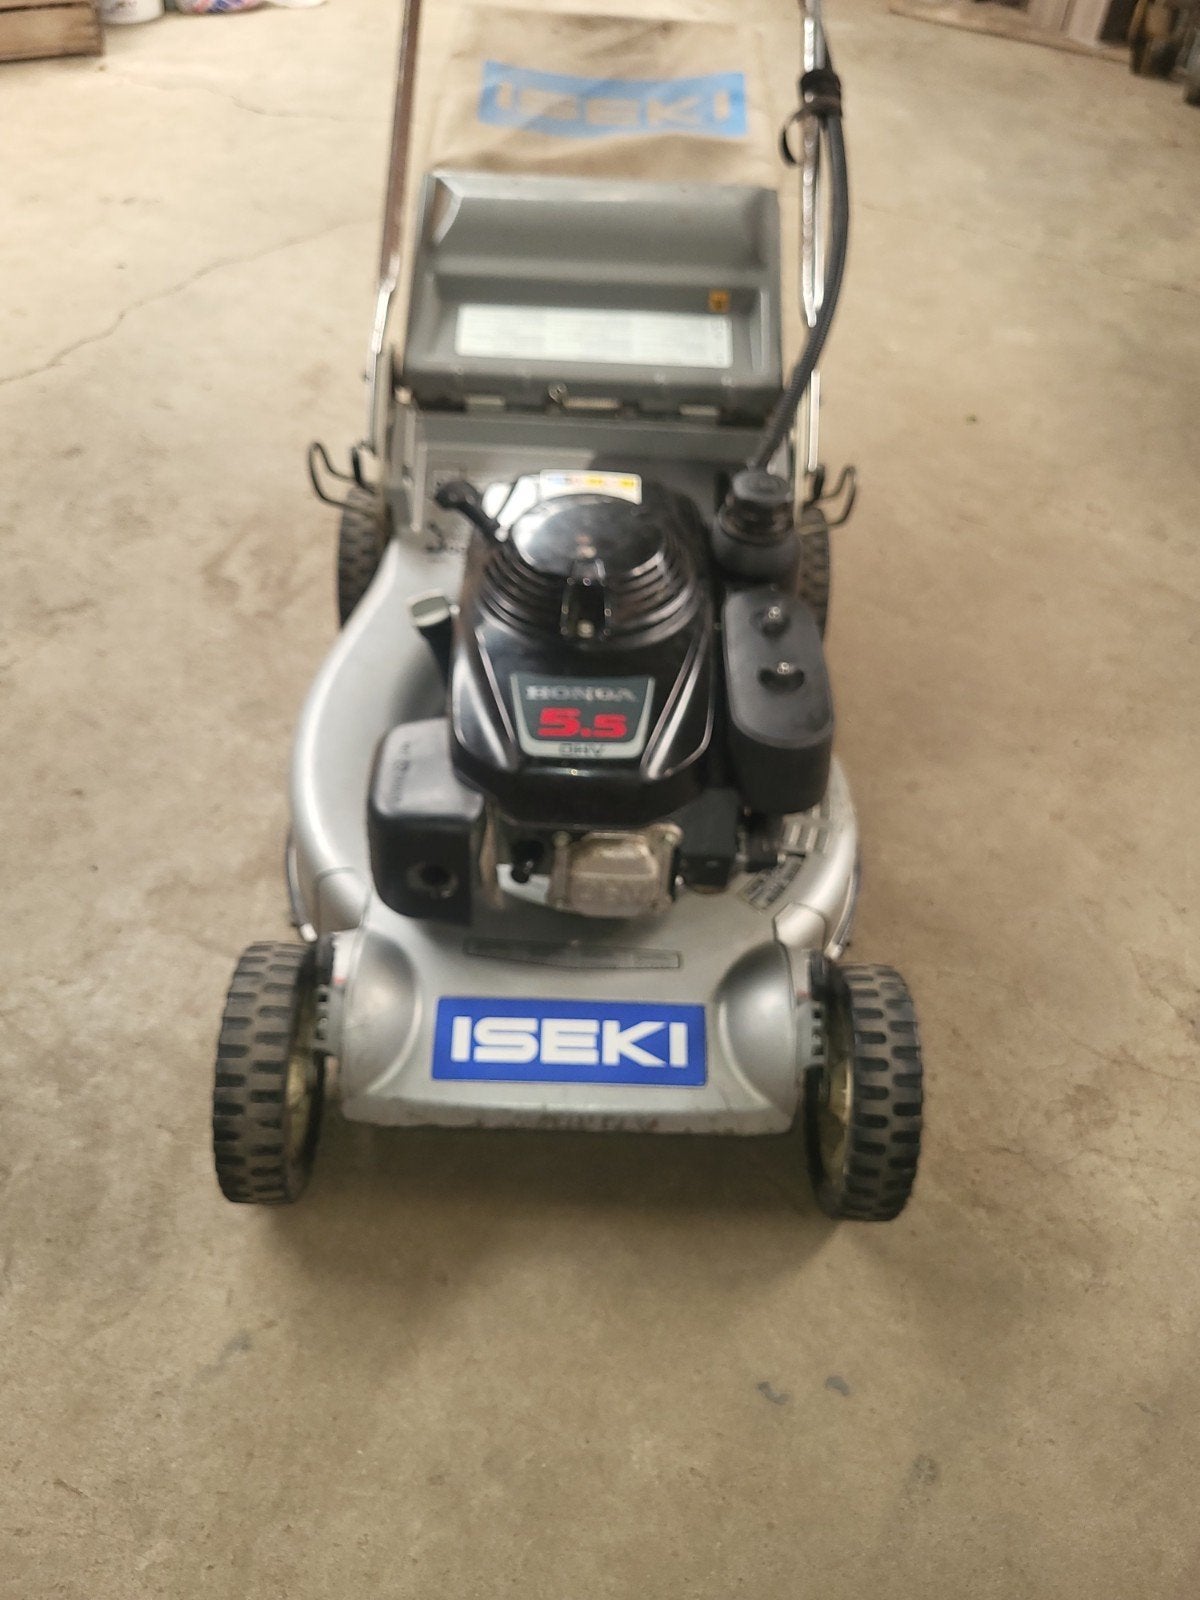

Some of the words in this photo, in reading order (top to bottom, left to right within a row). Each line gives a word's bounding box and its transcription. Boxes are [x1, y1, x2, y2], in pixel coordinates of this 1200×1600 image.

[526, 685, 637, 701] HONDA
[537, 707, 628, 738] 5.5
[450, 1015, 689, 1069] ISEKI
